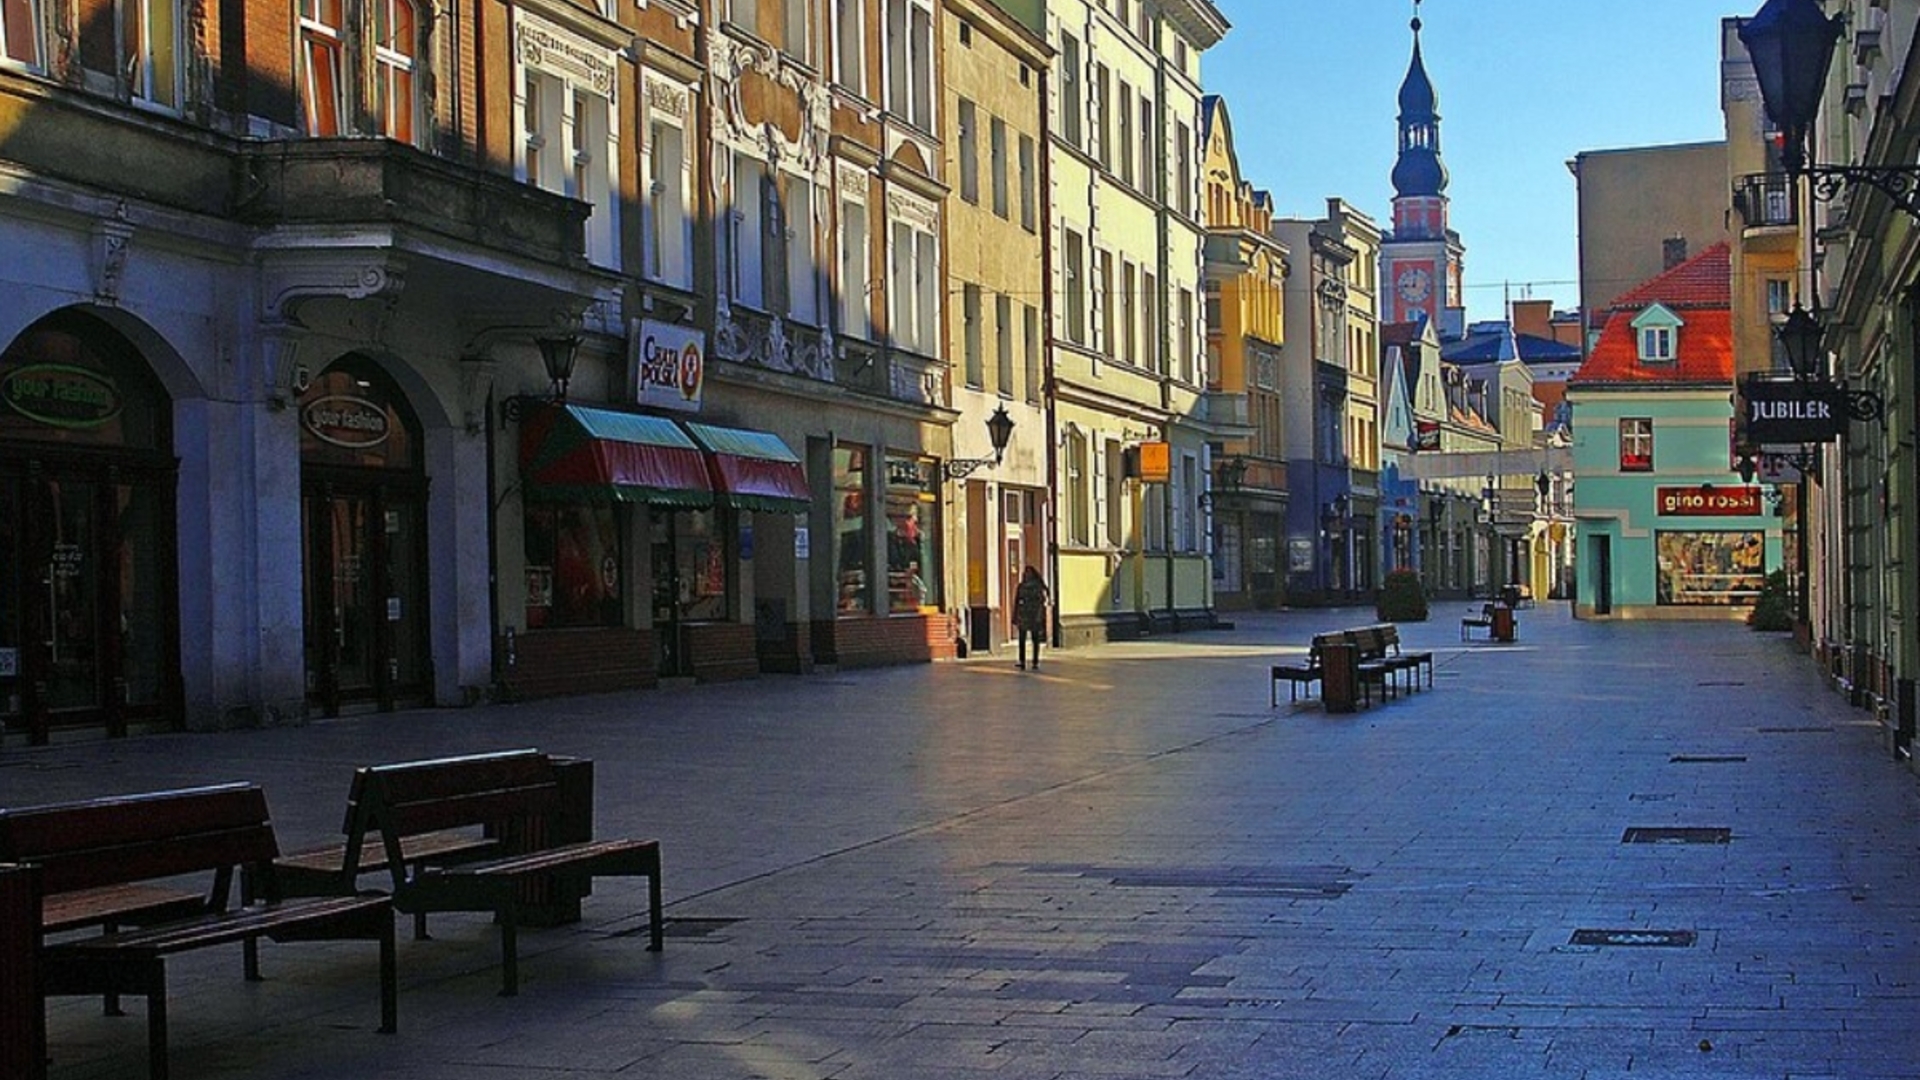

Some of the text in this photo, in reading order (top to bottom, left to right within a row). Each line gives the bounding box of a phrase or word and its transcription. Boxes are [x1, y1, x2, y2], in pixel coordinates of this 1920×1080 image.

[311, 408, 383, 432] your fashion
[1751, 400, 1831, 422] JUBILER
[1664, 491, 1754, 511] gino rossi
